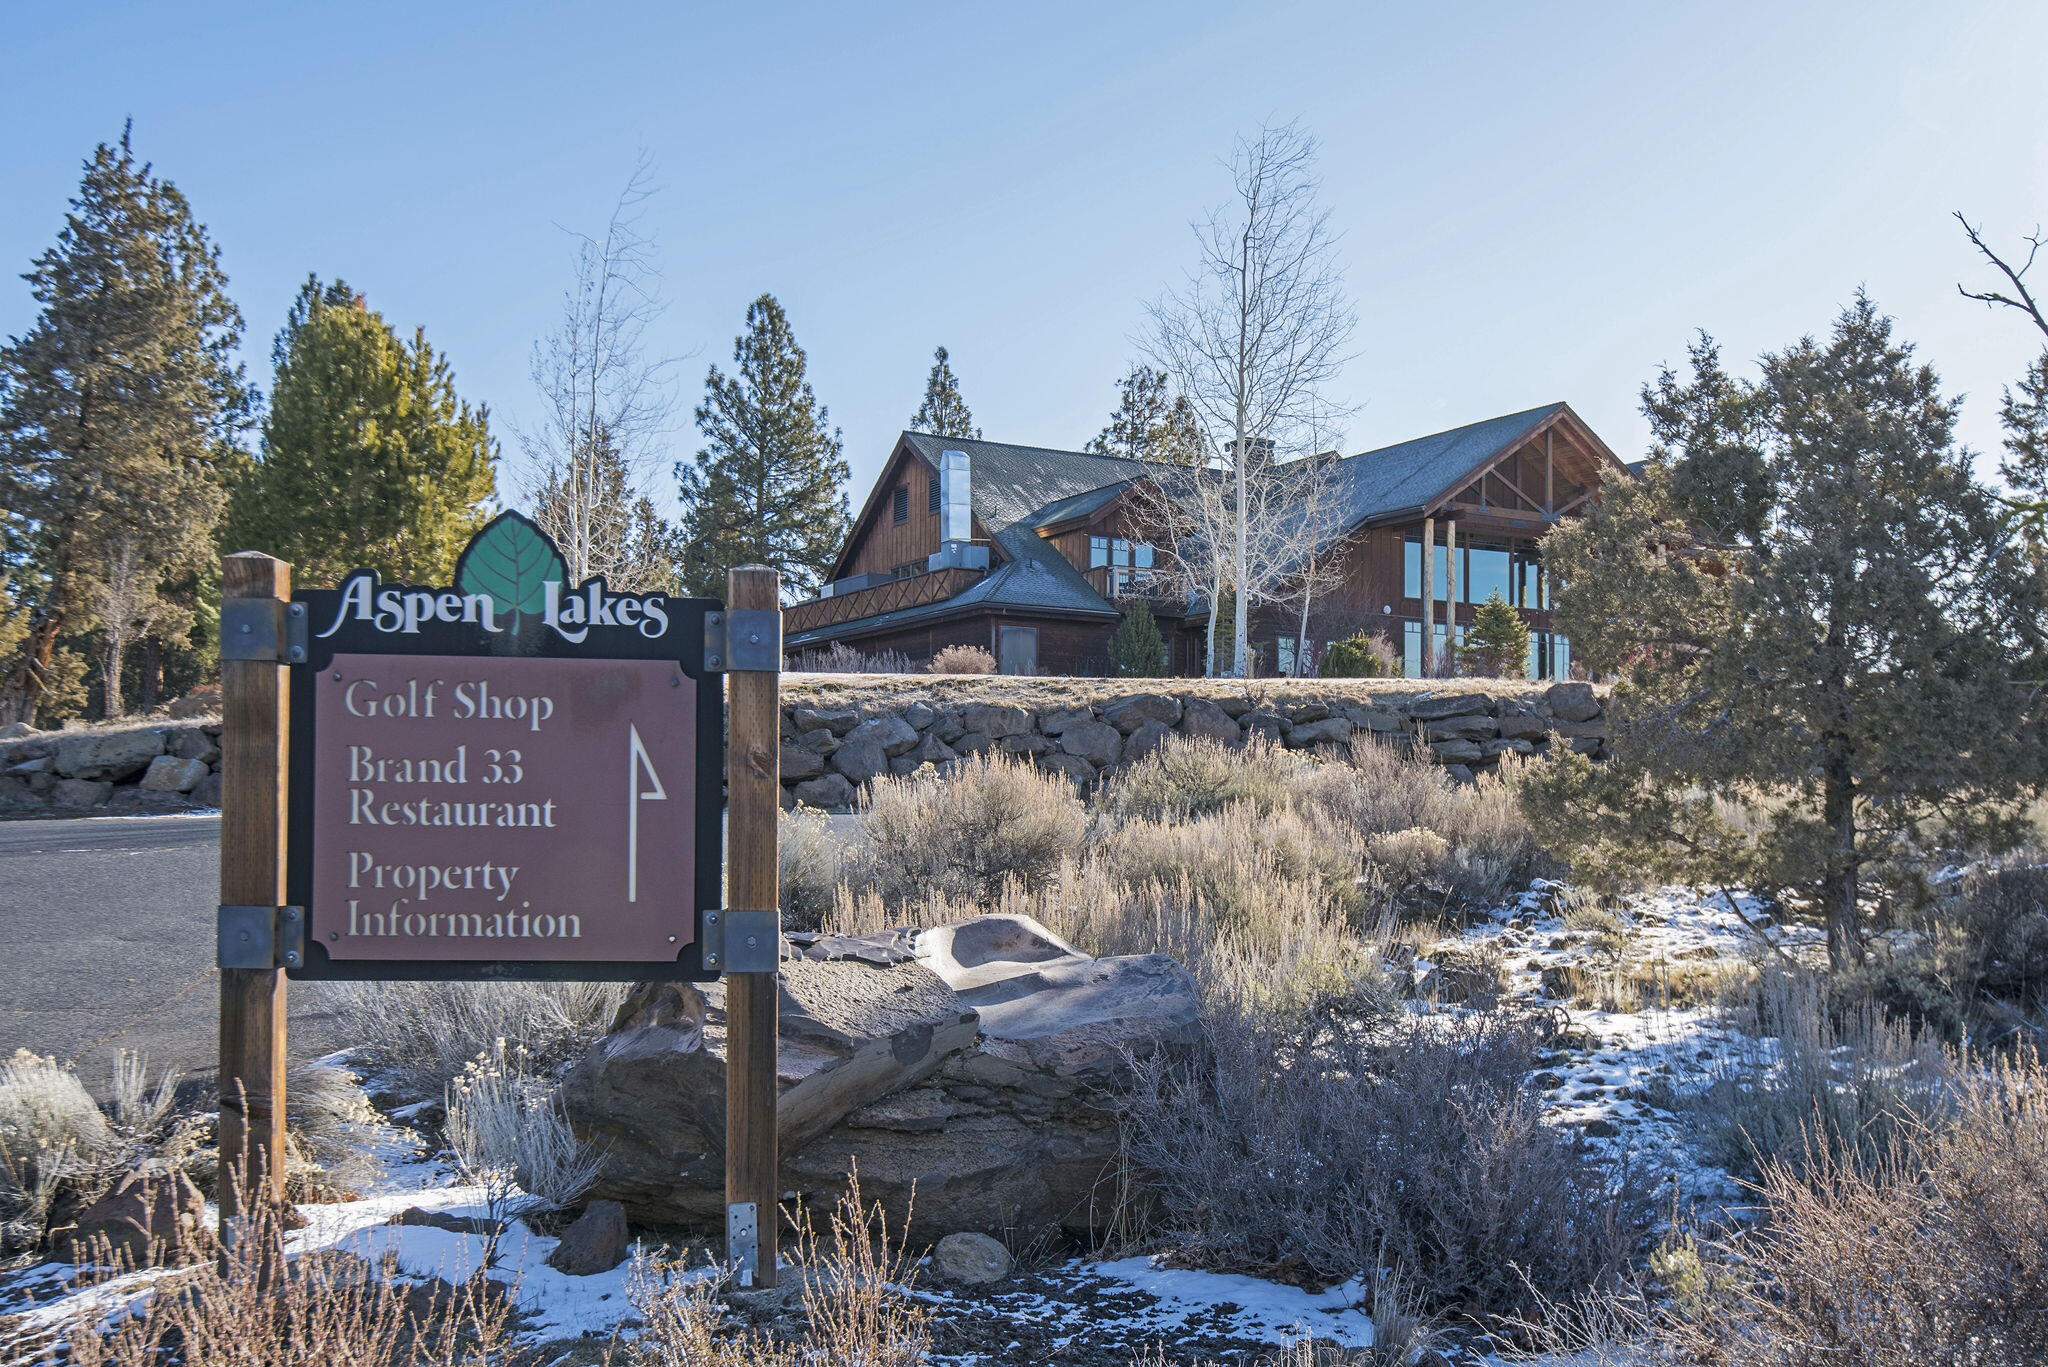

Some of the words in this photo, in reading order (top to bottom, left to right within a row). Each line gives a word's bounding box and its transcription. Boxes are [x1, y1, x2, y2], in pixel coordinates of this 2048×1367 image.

[315, 575, 504, 638] Aspen
[541, 580, 669, 644] Lakes
[345, 679, 444, 719] Golf
[453, 680, 554, 732] Shop
[348, 744, 467, 784] Brand
[482, 750, 524, 784] 33
[348, 788, 558, 828] Restaurant
[347, 851, 520, 901] Property
[346, 899, 582, 939] Information
